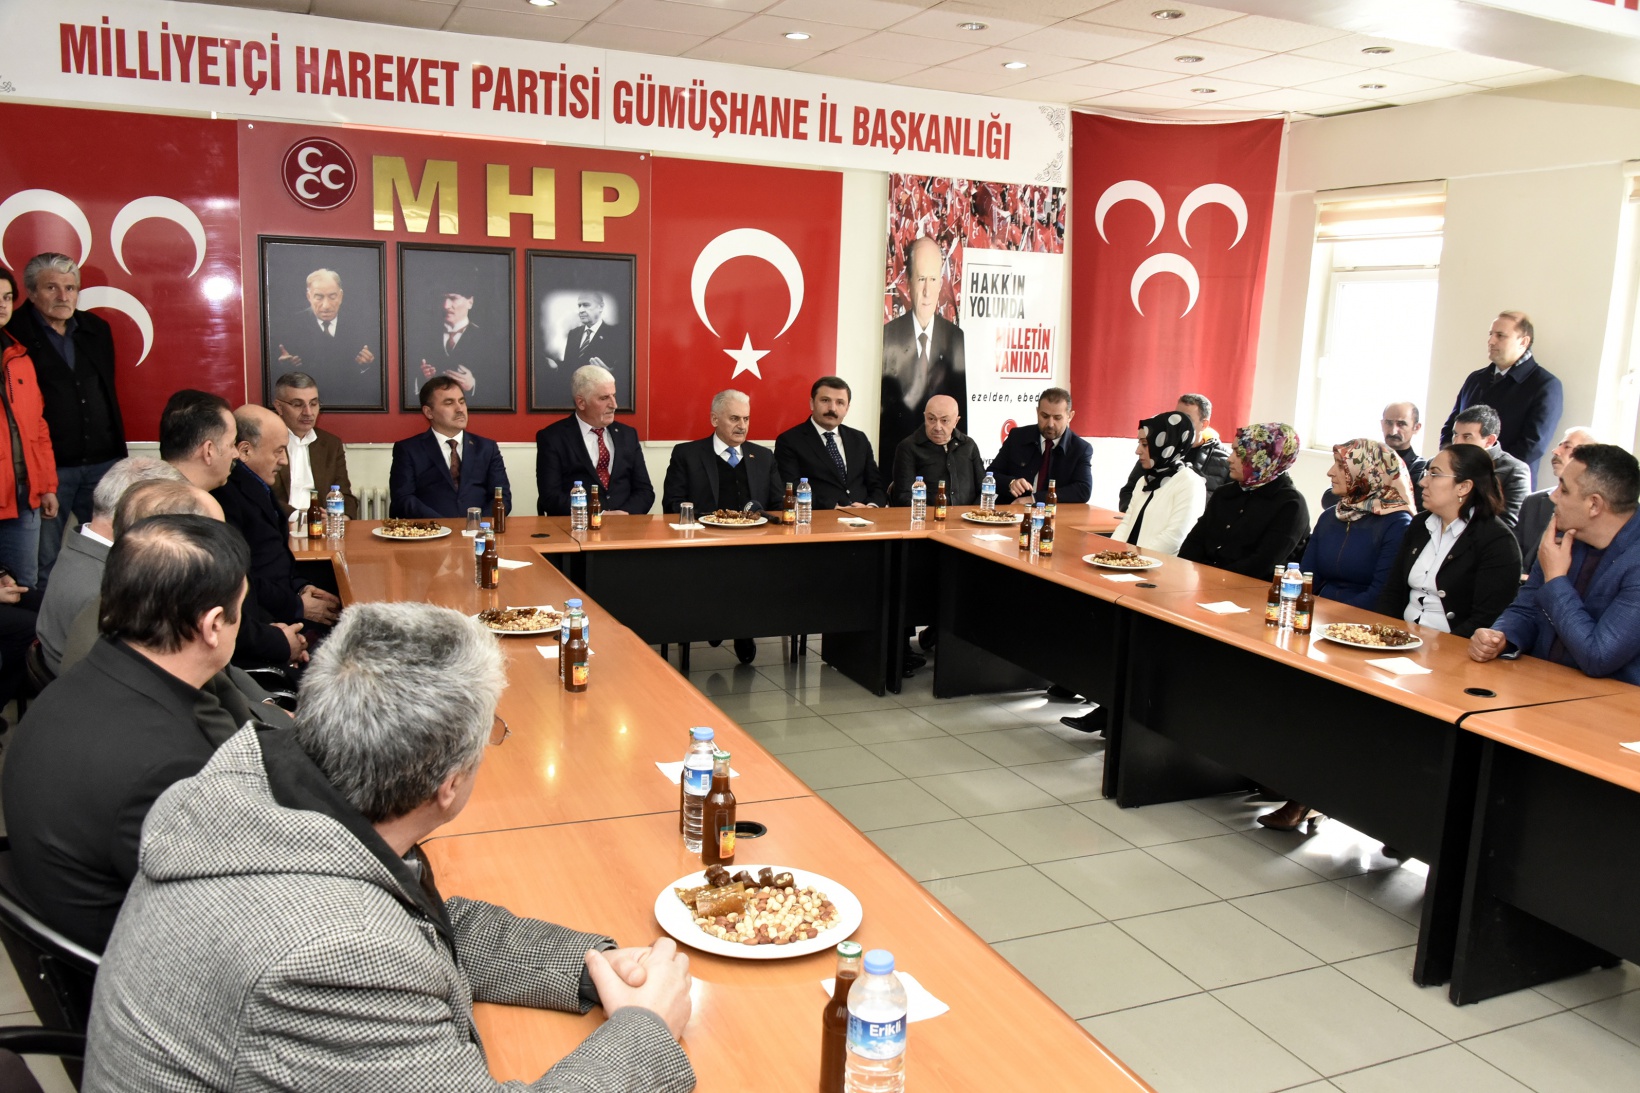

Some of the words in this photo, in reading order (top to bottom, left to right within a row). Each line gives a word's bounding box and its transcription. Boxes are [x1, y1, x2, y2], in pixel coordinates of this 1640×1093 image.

[60, 16, 281, 96] MİLLİYETÇİ
[296, 46, 460, 107] HAREKET
[472, 63, 601, 120] PARTİSİ
[612, 73, 809, 141] GÜMÜŞHANE
[818, 93, 843, 144] İL
[852, 105, 1012, 161] BAŞKANLIĞI
[372, 154, 641, 243] MHP
[970, 271, 1026, 296] HAKK'IN
[969, 295, 1025, 320] YOLUNDA
[971, 391, 1013, 404] ezelden,
[869, 1020, 902, 1037] Erikli
